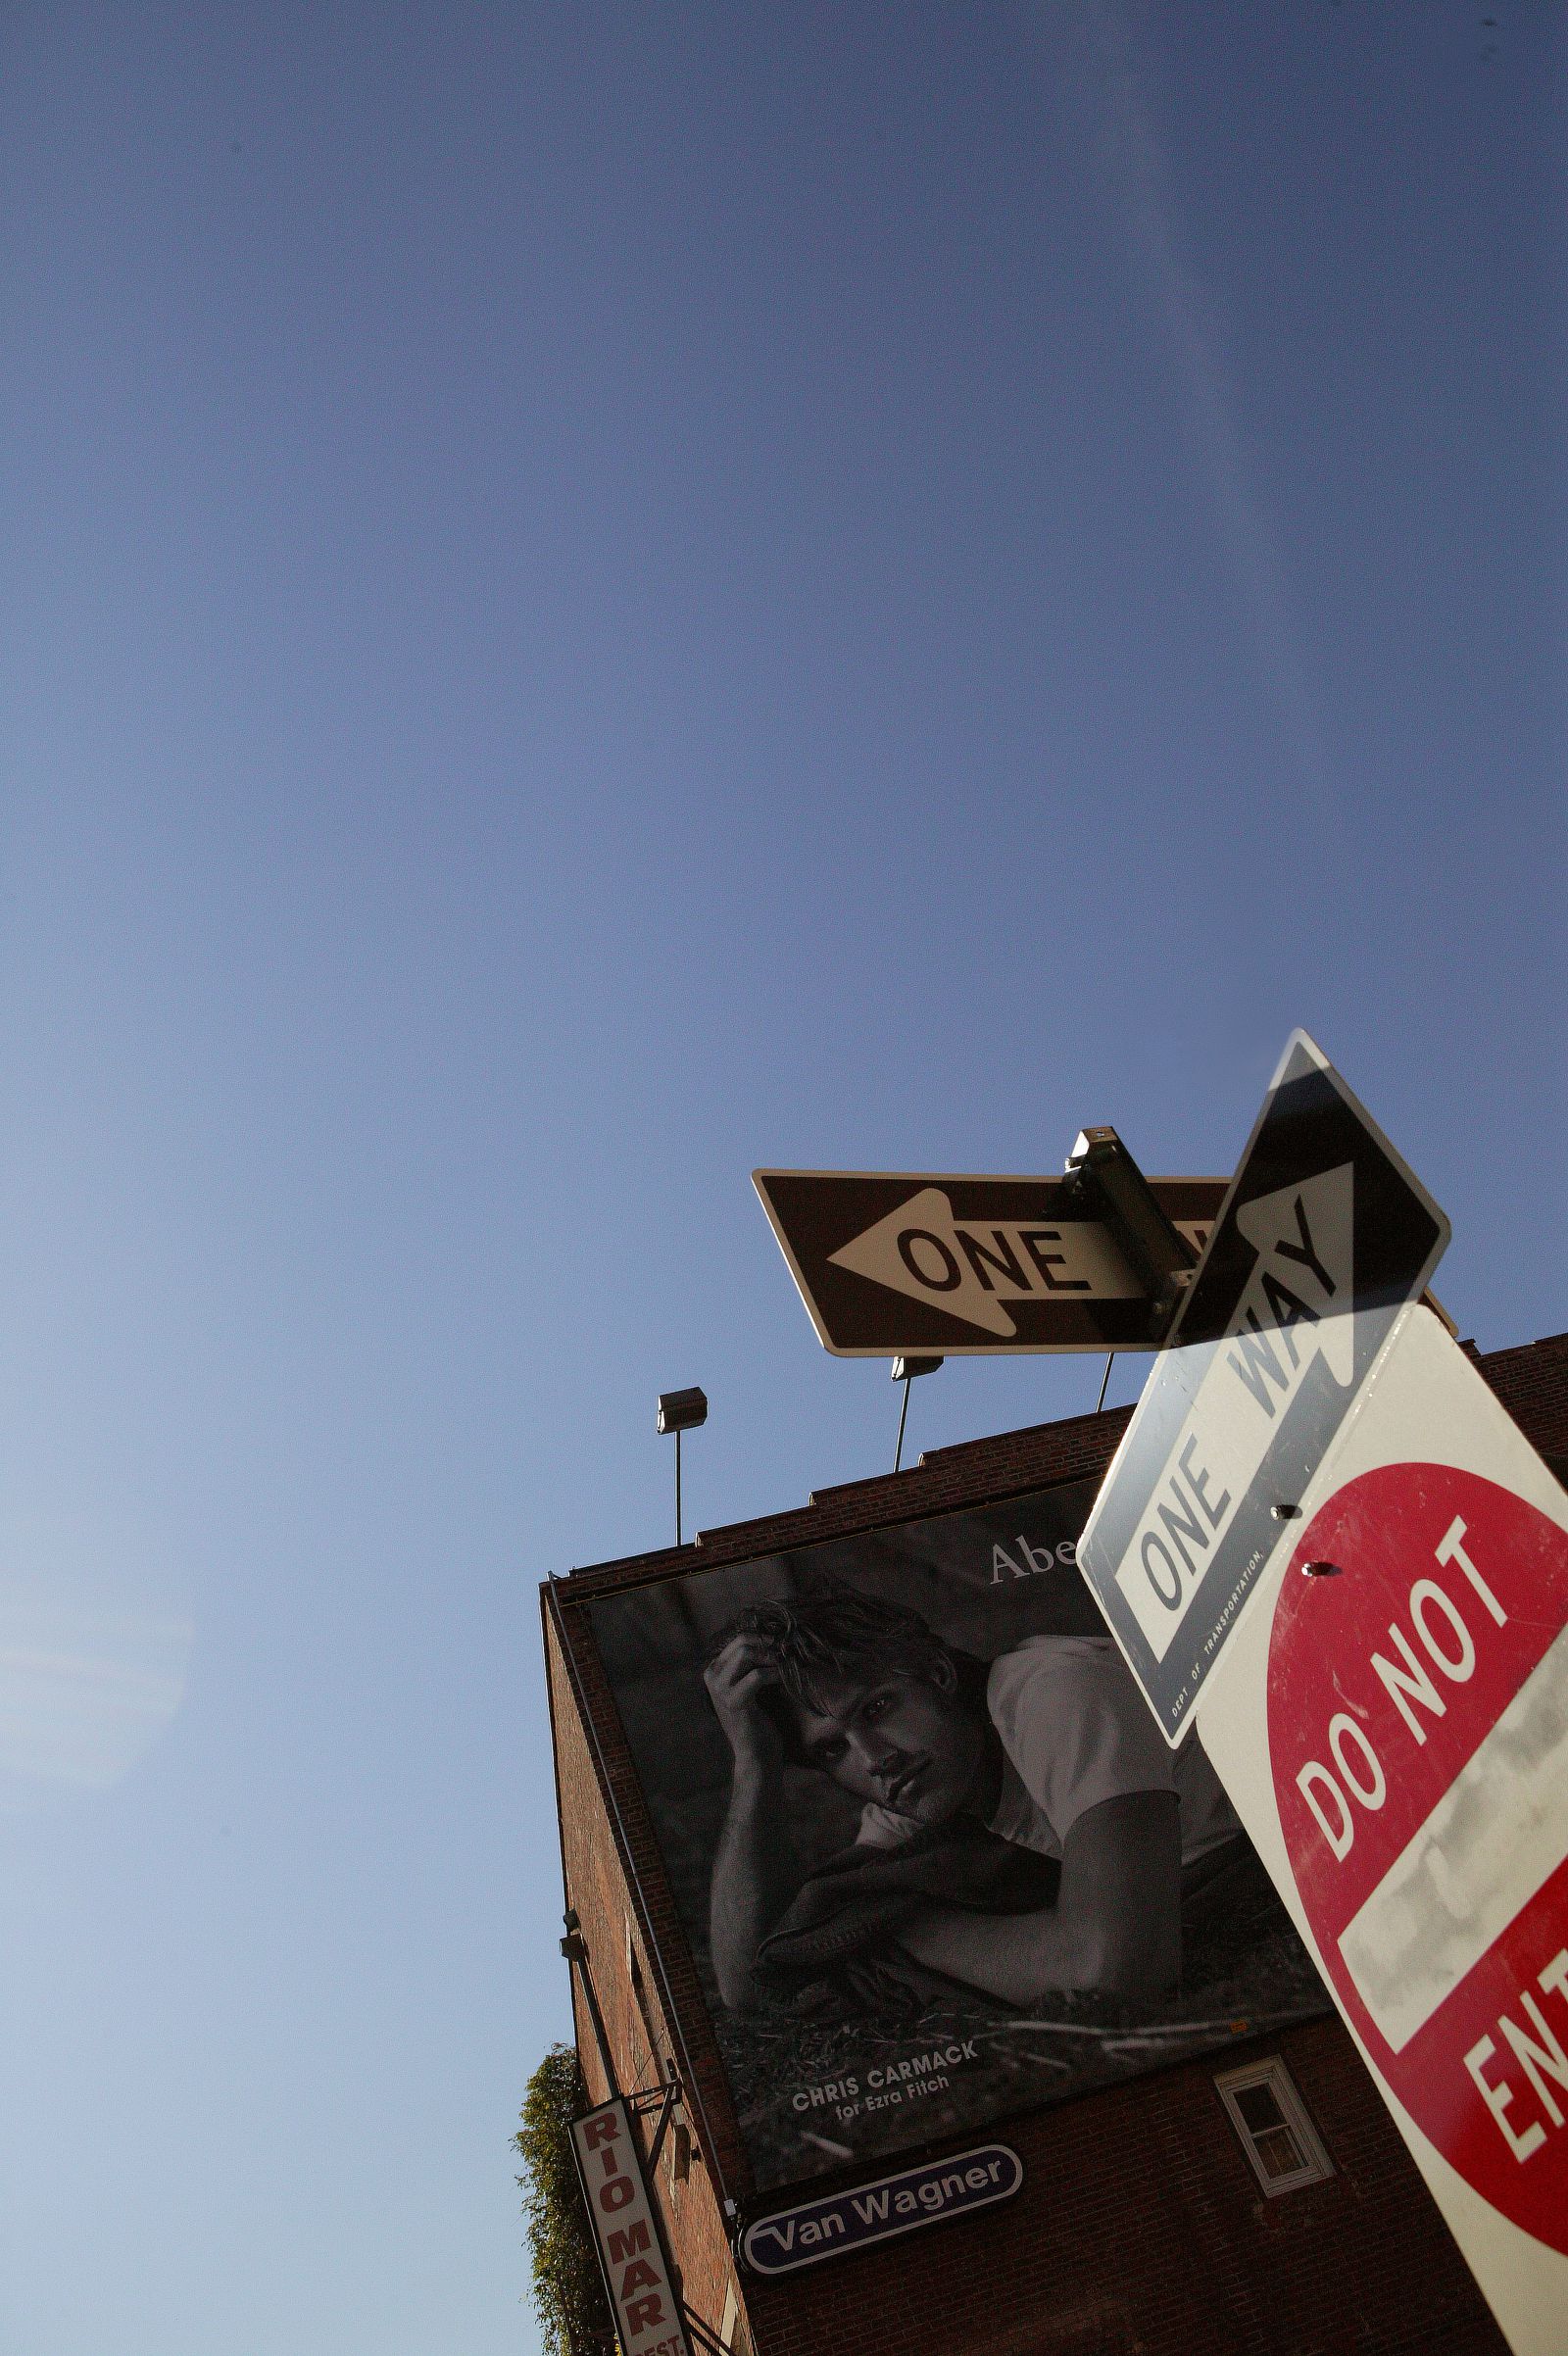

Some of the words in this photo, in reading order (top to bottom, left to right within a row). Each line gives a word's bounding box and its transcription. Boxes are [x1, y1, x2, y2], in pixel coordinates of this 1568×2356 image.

[897, 1228, 1093, 1293] ONE
[1141, 1433, 1232, 1612] ONE
[1225, 1193, 1337, 1420] WAY
[990, 1535, 1077, 1585] Abe
[1170, 1687, 1189, 1718] DEPT
[1191, 1662, 1201, 1681] OF
[1295, 1712, 1387, 1863] DO
[1369, 1514, 1509, 1747] NOT
[792, 2077, 859, 2111] CHRIS
[866, 2039, 979, 2088] CARMACK
[835, 2100, 859, 2121] for
[864, 2090, 903, 2112] Ezra
[906, 2075, 951, 2100] Fitch
[582, 2111, 636, 2214] RIO
[753, 2211, 847, 2252] Van
[850, 2159, 1002, 2225] Wagner
[606, 2218, 667, 2337] MAR
